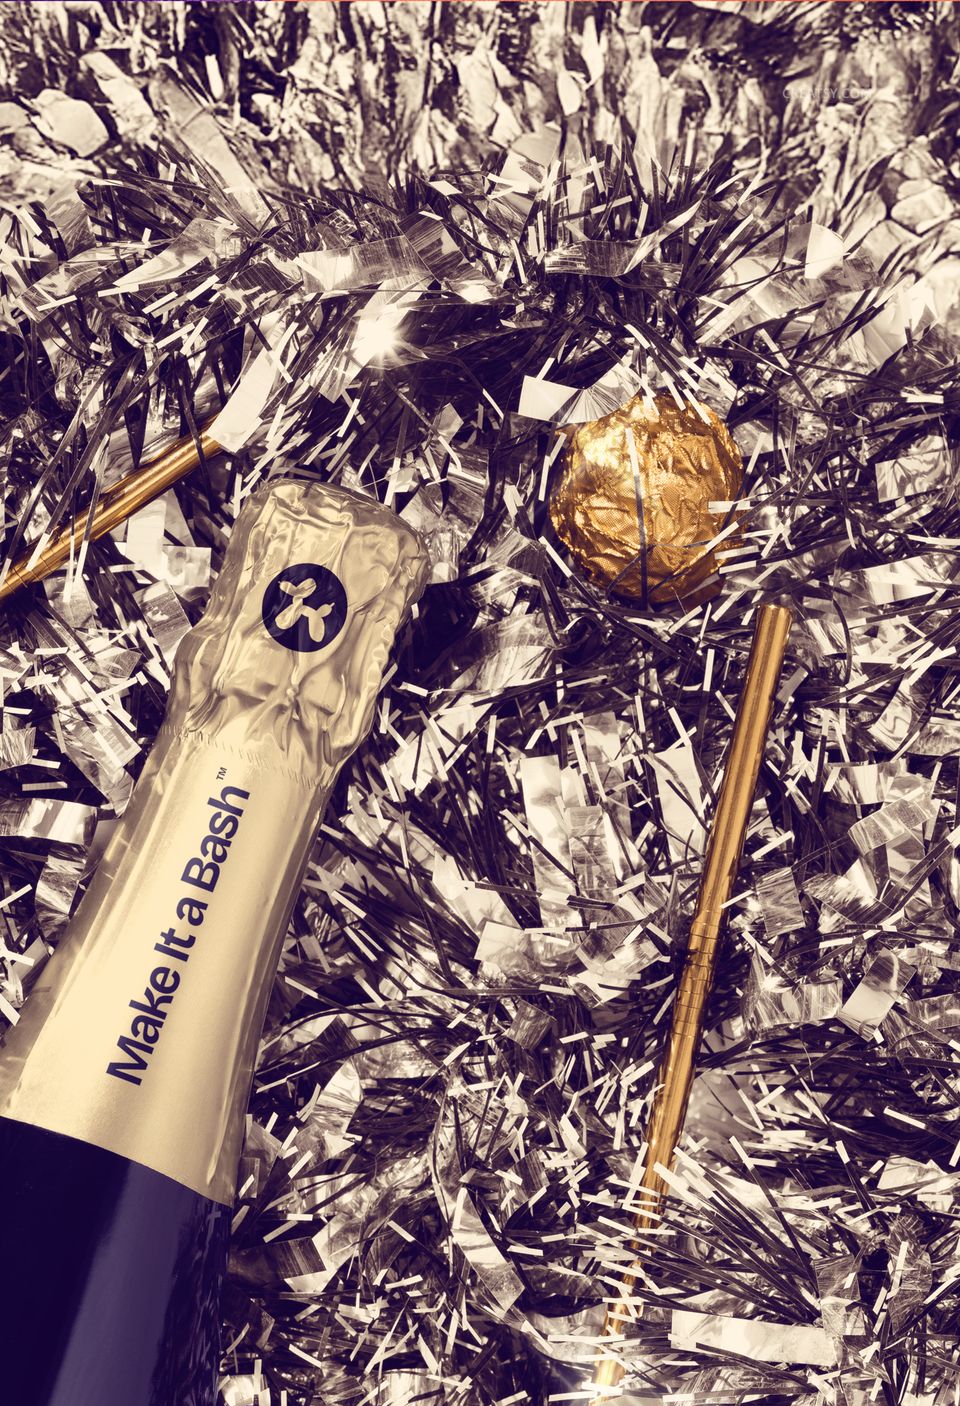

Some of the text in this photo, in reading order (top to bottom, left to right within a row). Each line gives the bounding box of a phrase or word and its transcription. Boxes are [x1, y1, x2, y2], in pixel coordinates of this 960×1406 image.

[180, 785, 251, 893] Bash
[154, 927, 196, 962] It
[176, 897, 209, 927] a
[106, 966, 181, 1086] Make
